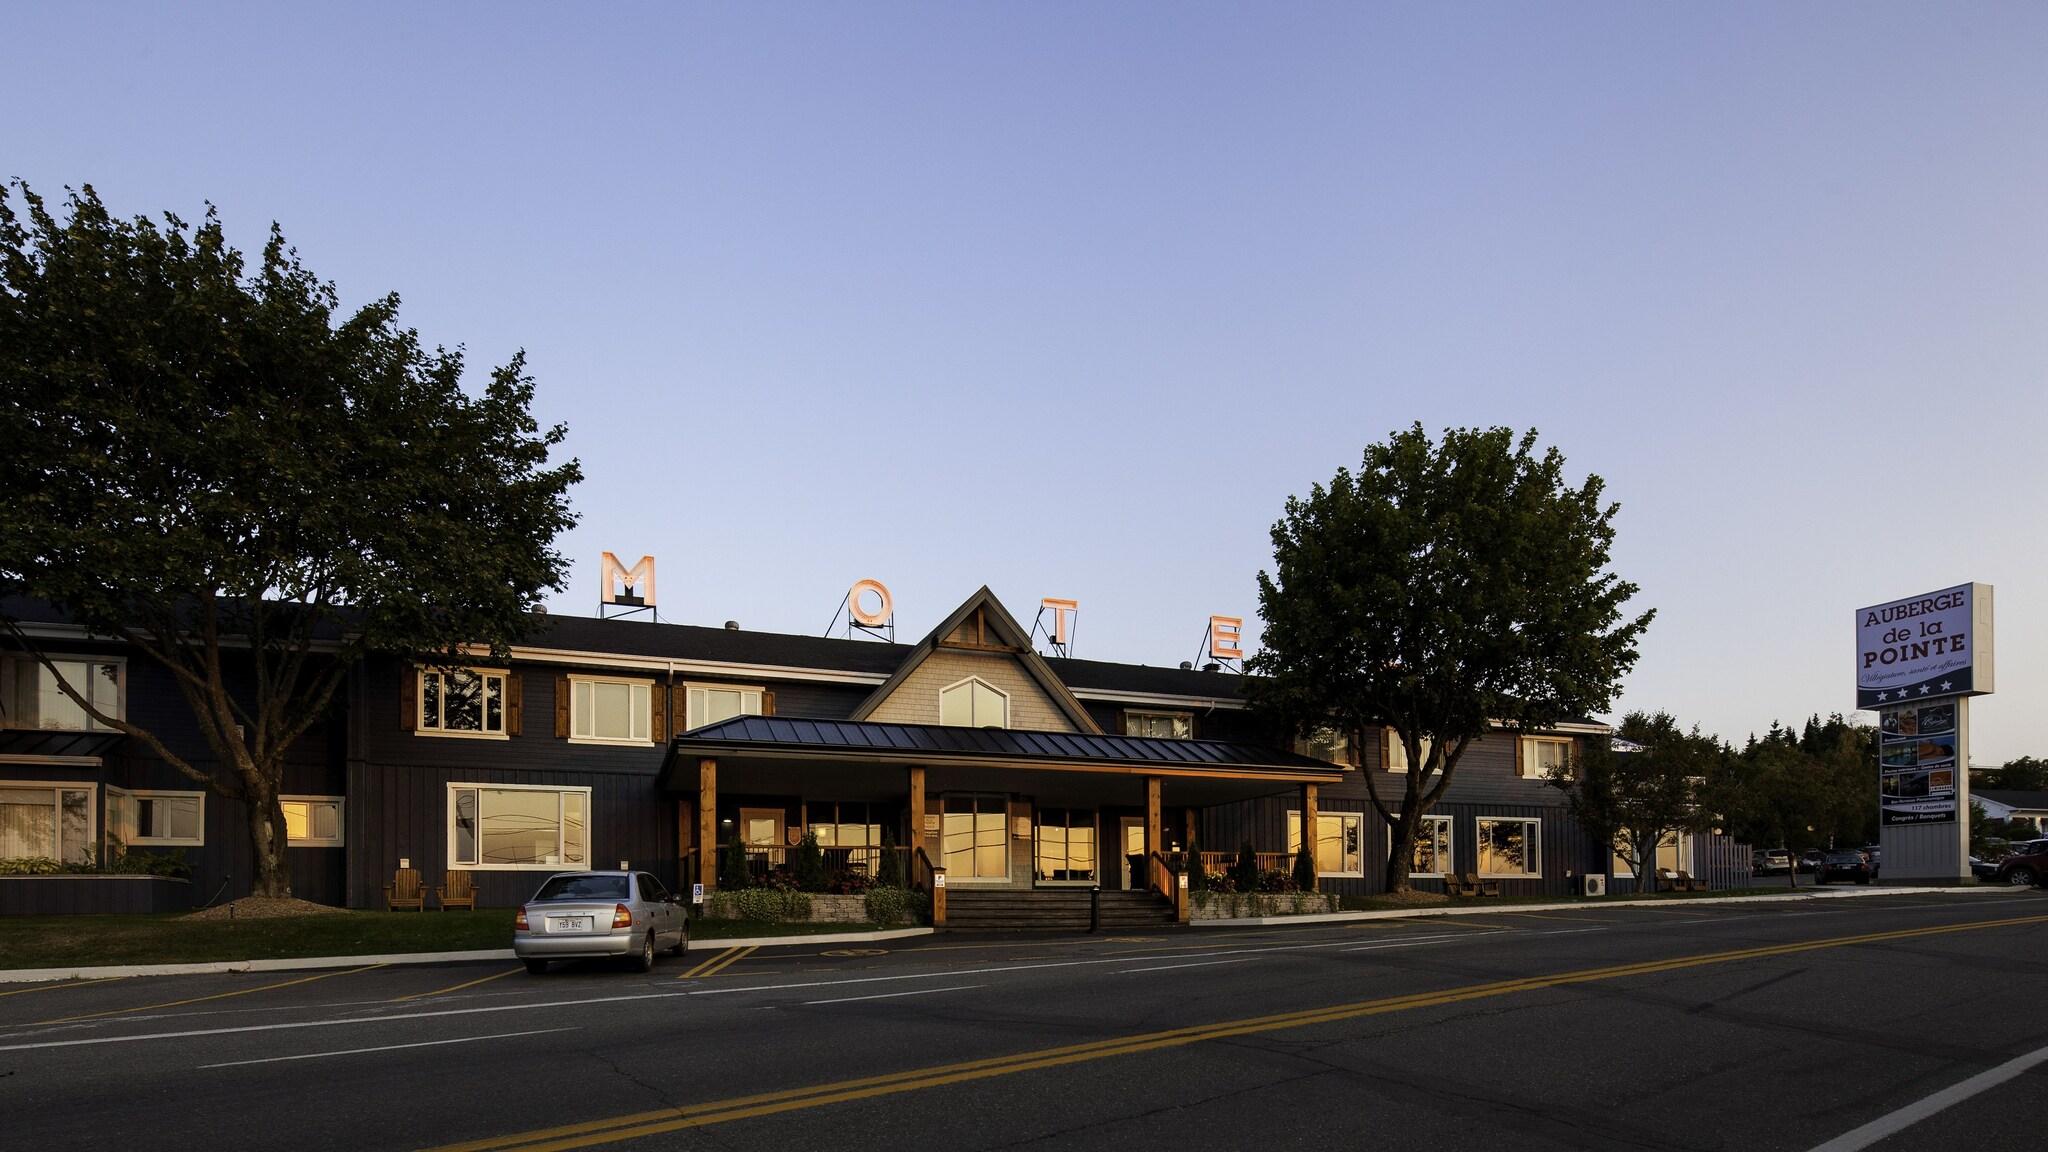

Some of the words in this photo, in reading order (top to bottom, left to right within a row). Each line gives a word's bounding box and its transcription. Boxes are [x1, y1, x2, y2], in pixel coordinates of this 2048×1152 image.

[1864, 591, 1964, 627] AUBERGE
[1863, 633, 1965, 669] POINTE
[1882, 627, 1911, 645] de
[1919, 621, 1943, 638] la
